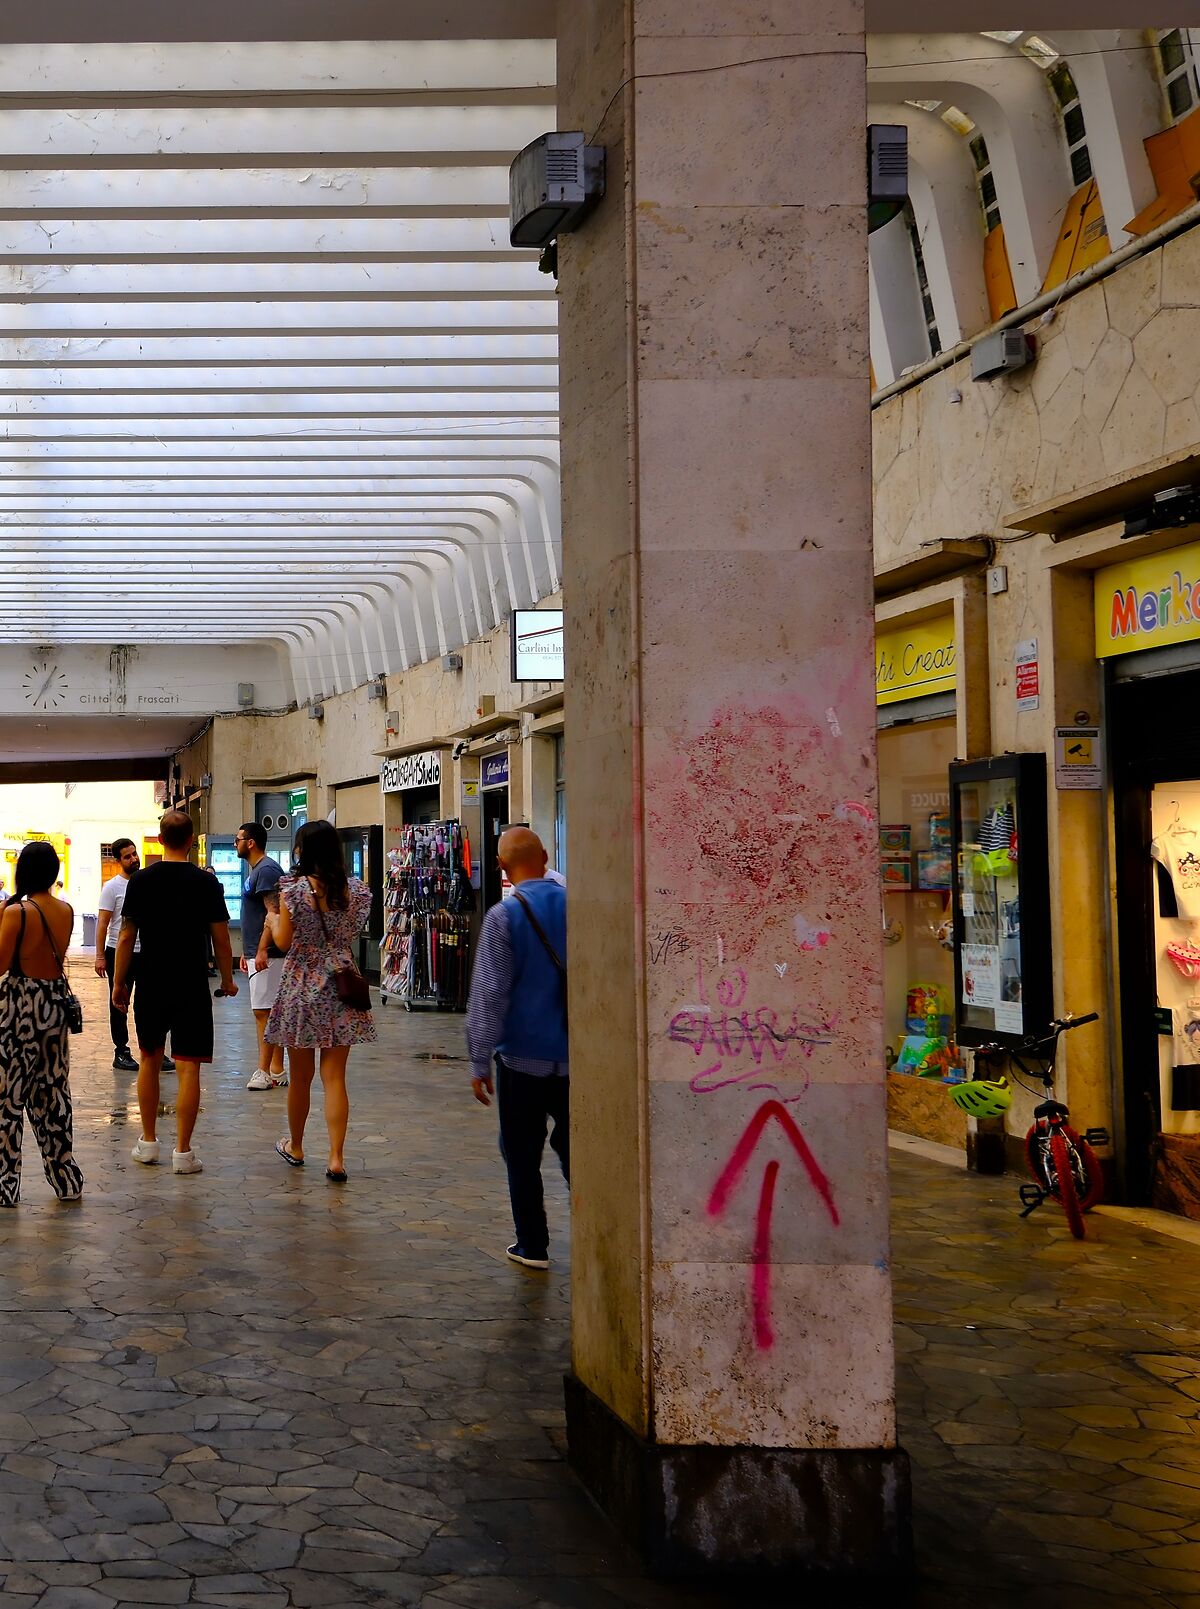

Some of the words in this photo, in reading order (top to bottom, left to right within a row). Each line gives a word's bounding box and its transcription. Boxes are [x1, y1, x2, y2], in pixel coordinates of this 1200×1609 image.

[992, 571, 999, 589] 8
[518, 643, 550, 653] Carlini
[138, 694, 180, 704] Frascati
